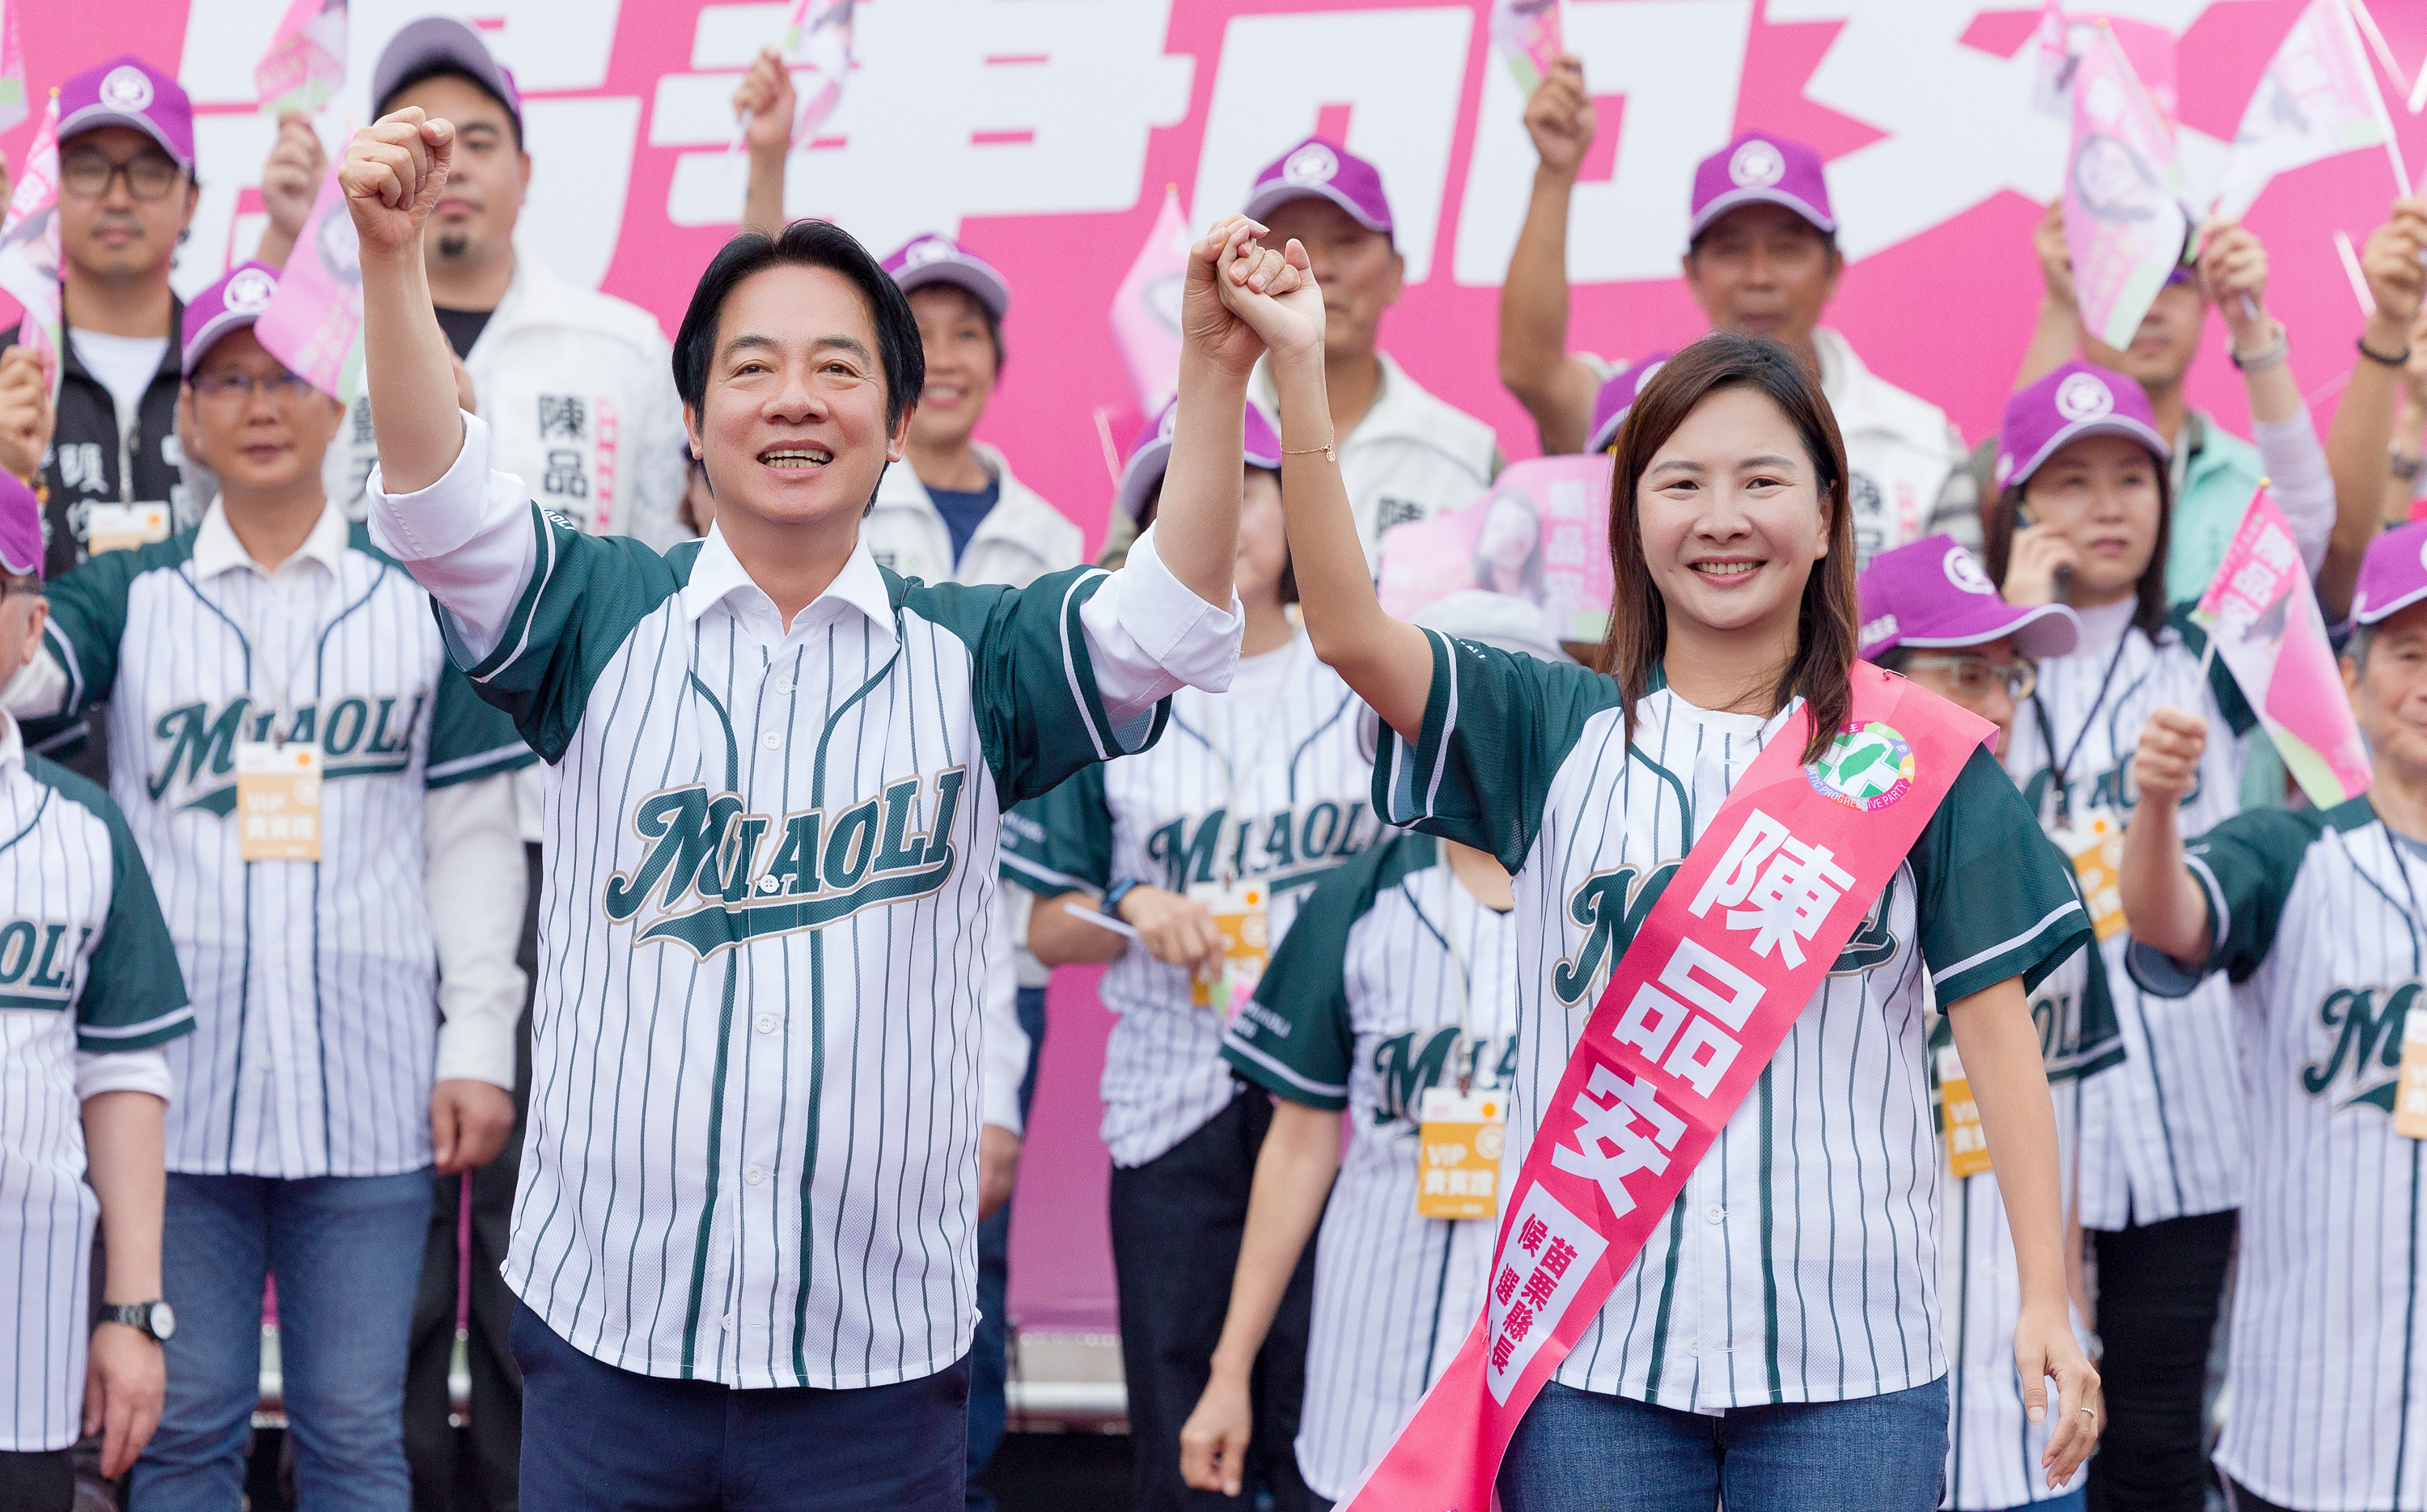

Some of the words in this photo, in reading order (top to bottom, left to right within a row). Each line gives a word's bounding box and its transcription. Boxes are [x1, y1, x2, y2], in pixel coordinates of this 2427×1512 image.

[604, 764, 968, 925] MIAOLI
[1147, 800, 1385, 893] MIAOL
[1819, 786, 1883, 810] PROGRESSIVE
[1882, 781, 1908, 807] PARTY
[1550, 807, 1857, 1219] 陳品安
[1426, 1143, 1468, 1167] VIP
[1491, 1235, 1578, 1377] 苗栗縣長
